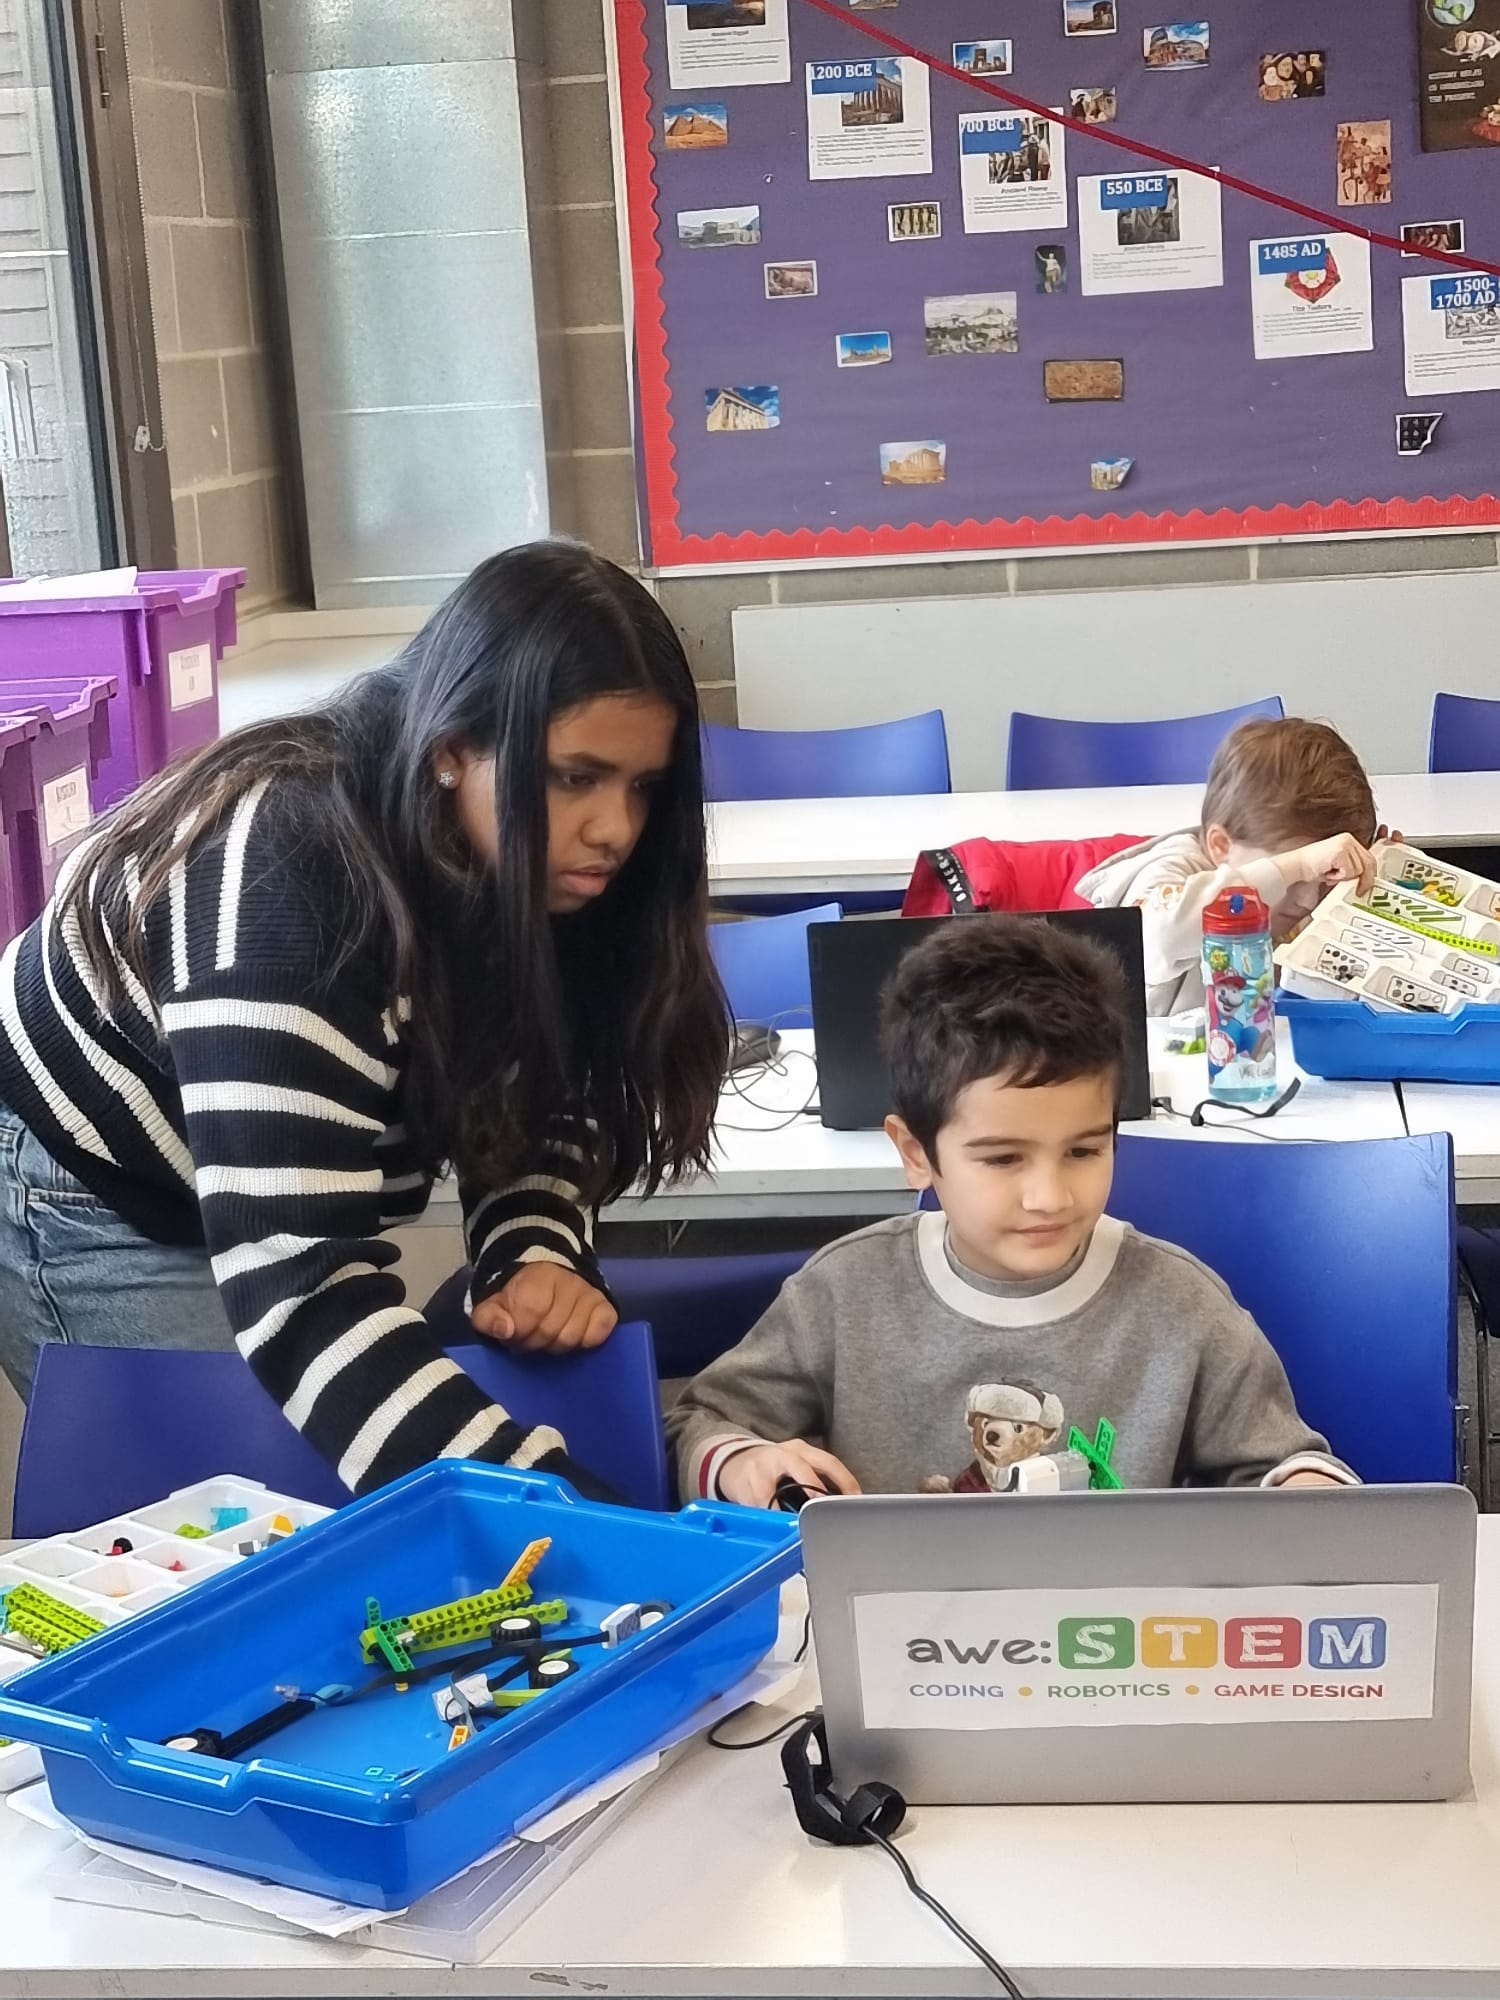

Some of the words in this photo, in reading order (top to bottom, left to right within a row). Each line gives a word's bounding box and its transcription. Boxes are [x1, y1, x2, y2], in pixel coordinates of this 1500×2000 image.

[811, 65, 842, 80] 1200
[845, 63, 873, 78] BCE
[987, 118, 1015, 132] BCE
[1106, 180, 1133, 196] 550
[1136, 178, 1164, 193] BCE
[1263, 244, 1298, 260] 1485
[1301, 242, 1322, 257] AD
[1454, 277, 1496, 293] 1500-
[1436, 293, 1472, 308] 1700
[1474, 290, 1496, 305] AD
[909, 1684, 1004, 1698] CODING
[1047, 1683, 1171, 1698] ROBOTICS
[1214, 1684, 1284, 1697] GAME
[1292, 1684, 1383, 1698] DESIGN
